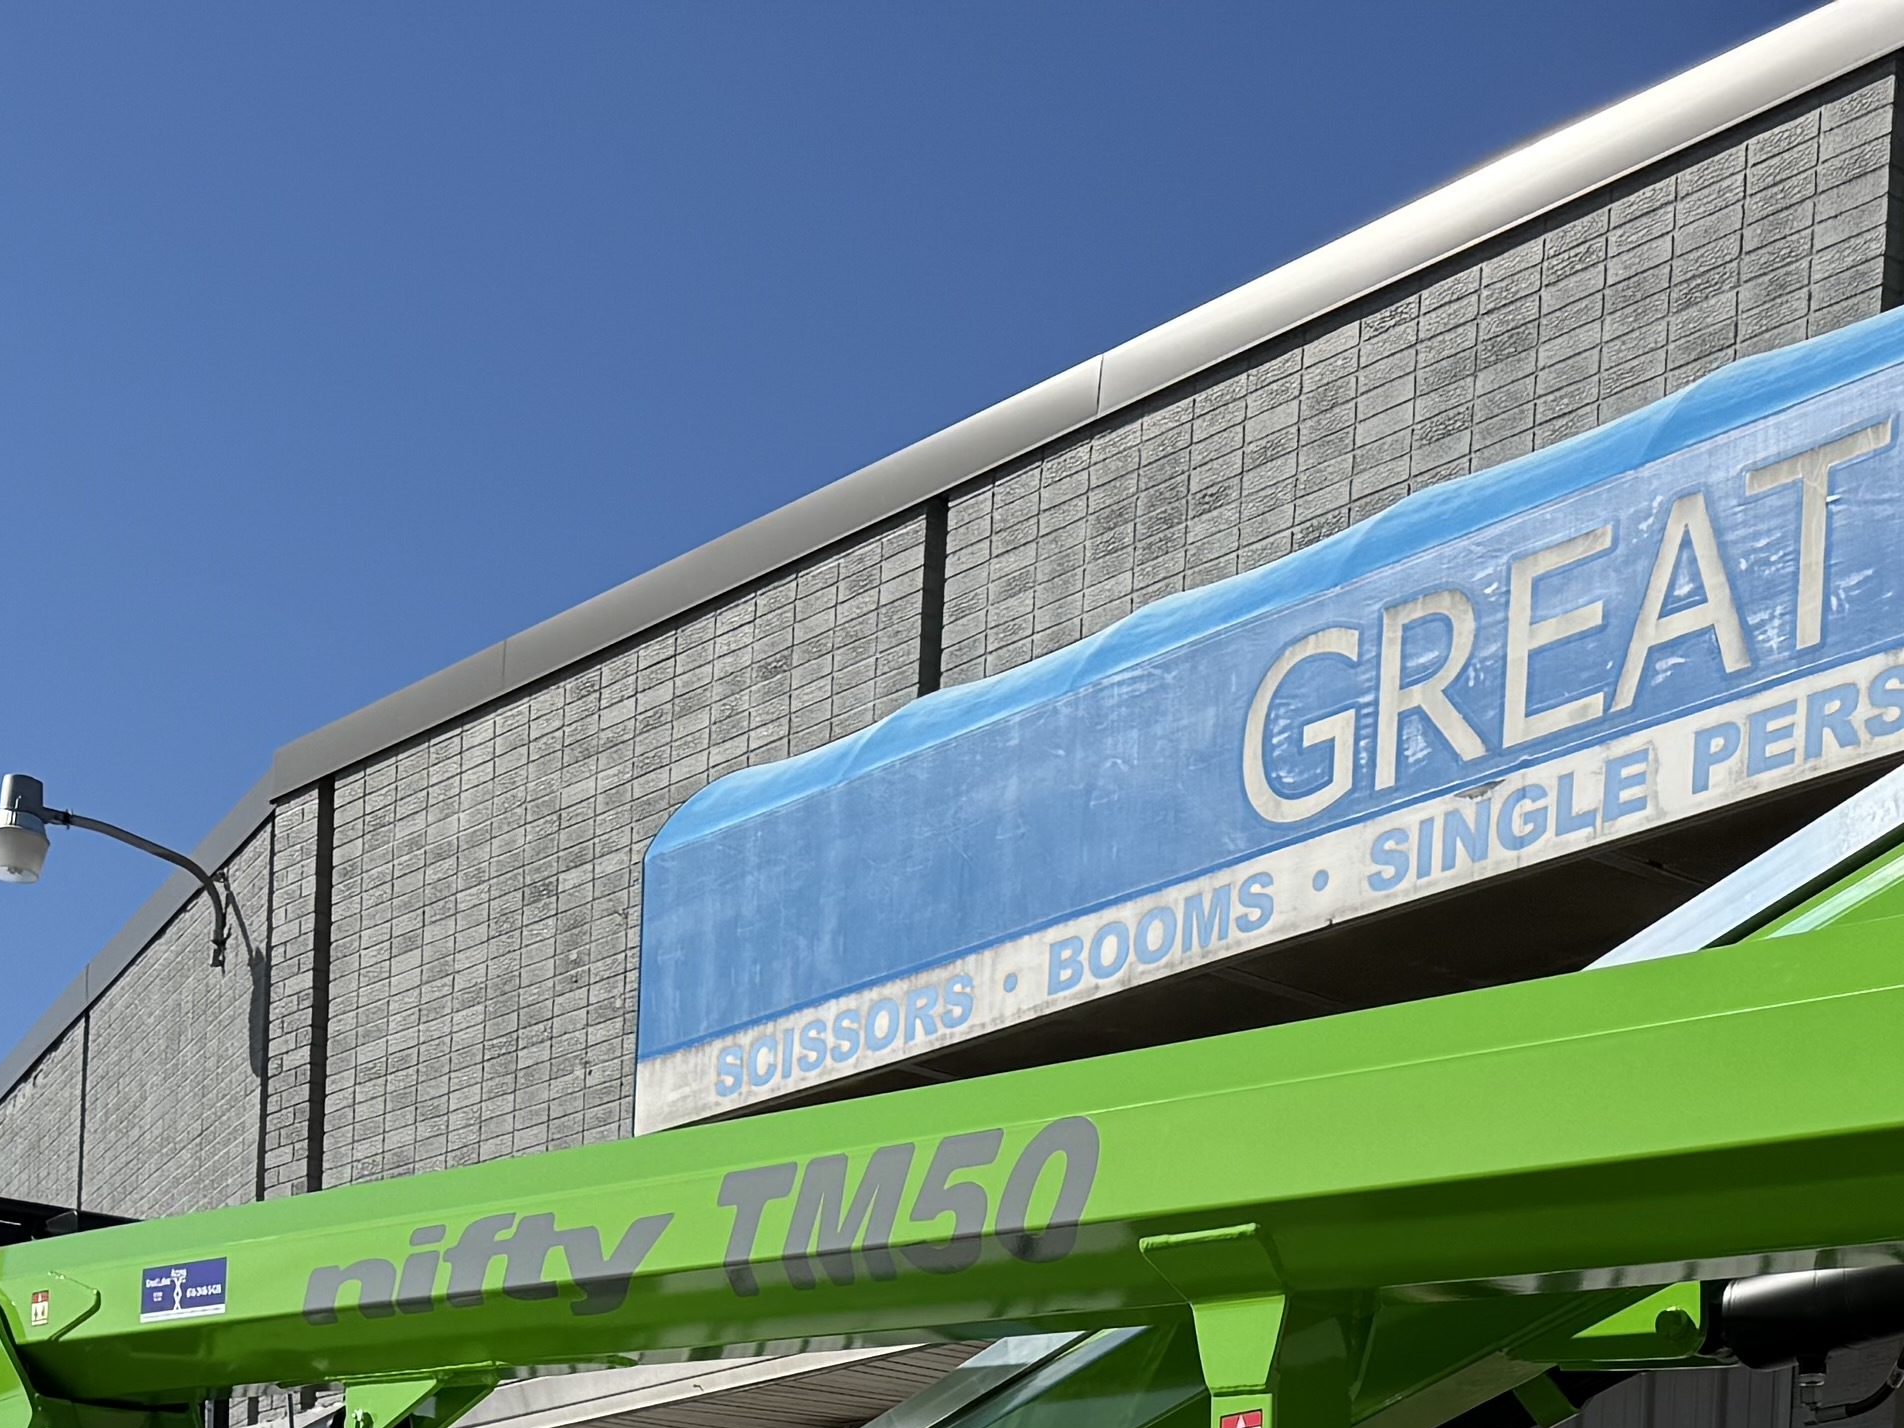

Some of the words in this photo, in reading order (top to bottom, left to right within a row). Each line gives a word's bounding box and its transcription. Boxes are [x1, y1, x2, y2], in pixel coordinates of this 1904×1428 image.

[1244, 415, 1892, 823] GREAT
[714, 974, 974, 1097] SCISSORS
[1047, 872, 1274, 996] BOOMS
[1368, 749, 1650, 892] SINGLE
[301, 1212, 675, 1325] nifty
[716, 1115, 1101, 1297] TM50
